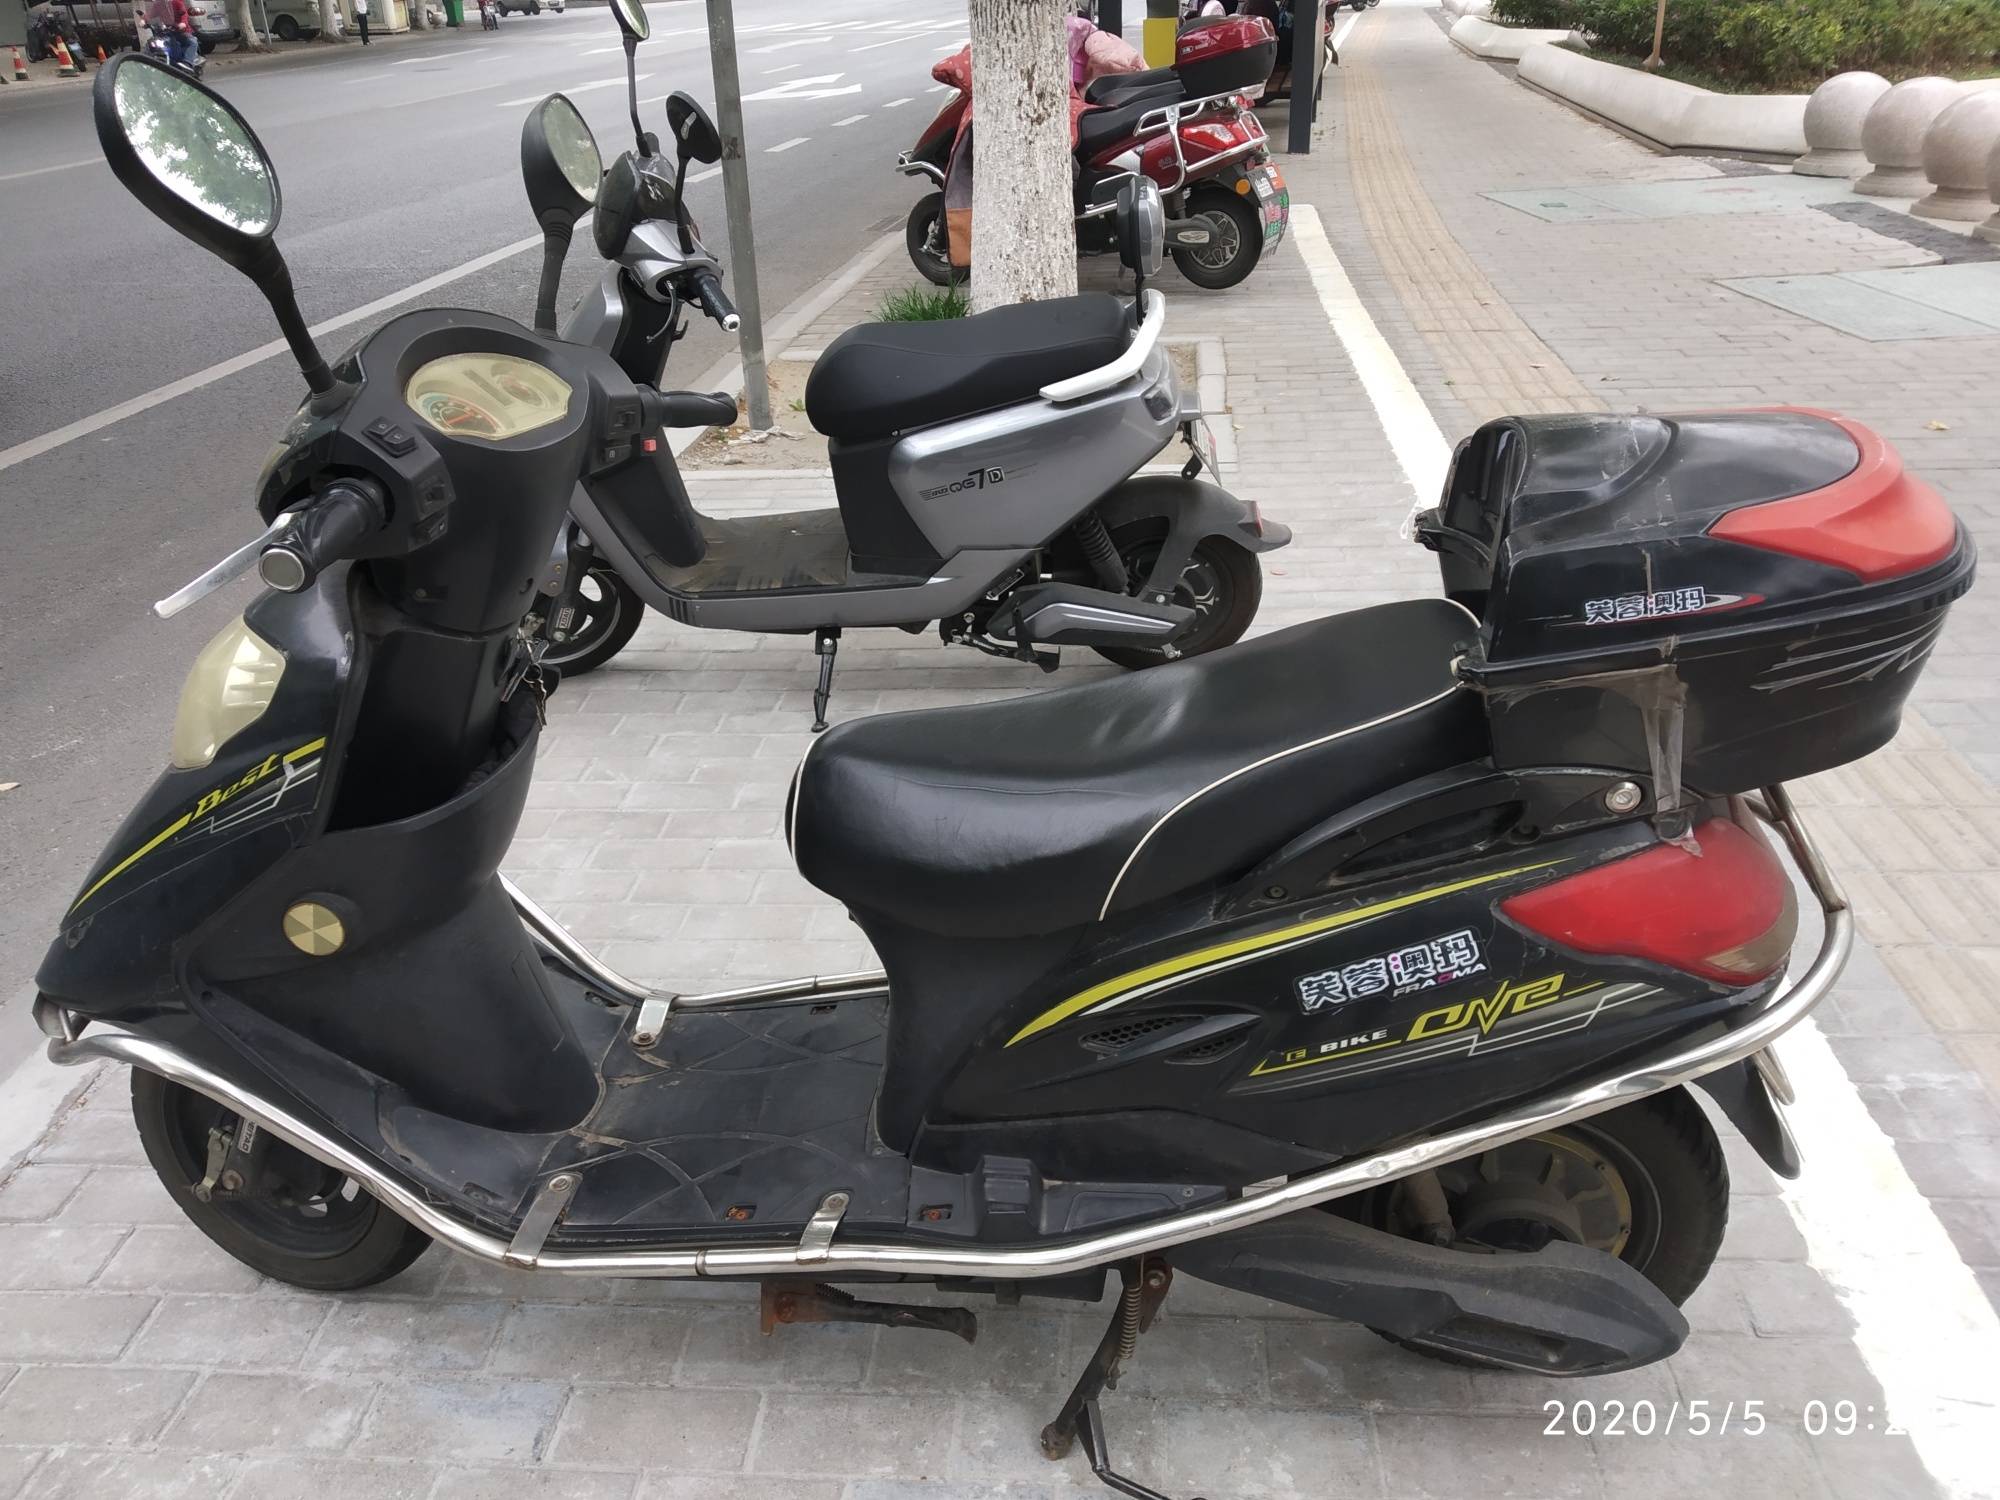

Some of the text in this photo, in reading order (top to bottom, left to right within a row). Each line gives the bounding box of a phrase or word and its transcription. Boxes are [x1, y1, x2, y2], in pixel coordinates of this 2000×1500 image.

[1585, 586, 1706, 626] 芙蓉澳玛
[191, 753, 279, 820] Best
[1299, 930, 1480, 1011] 芙蓉澳玛
[1320, 1029, 1388, 1053] BIKE
